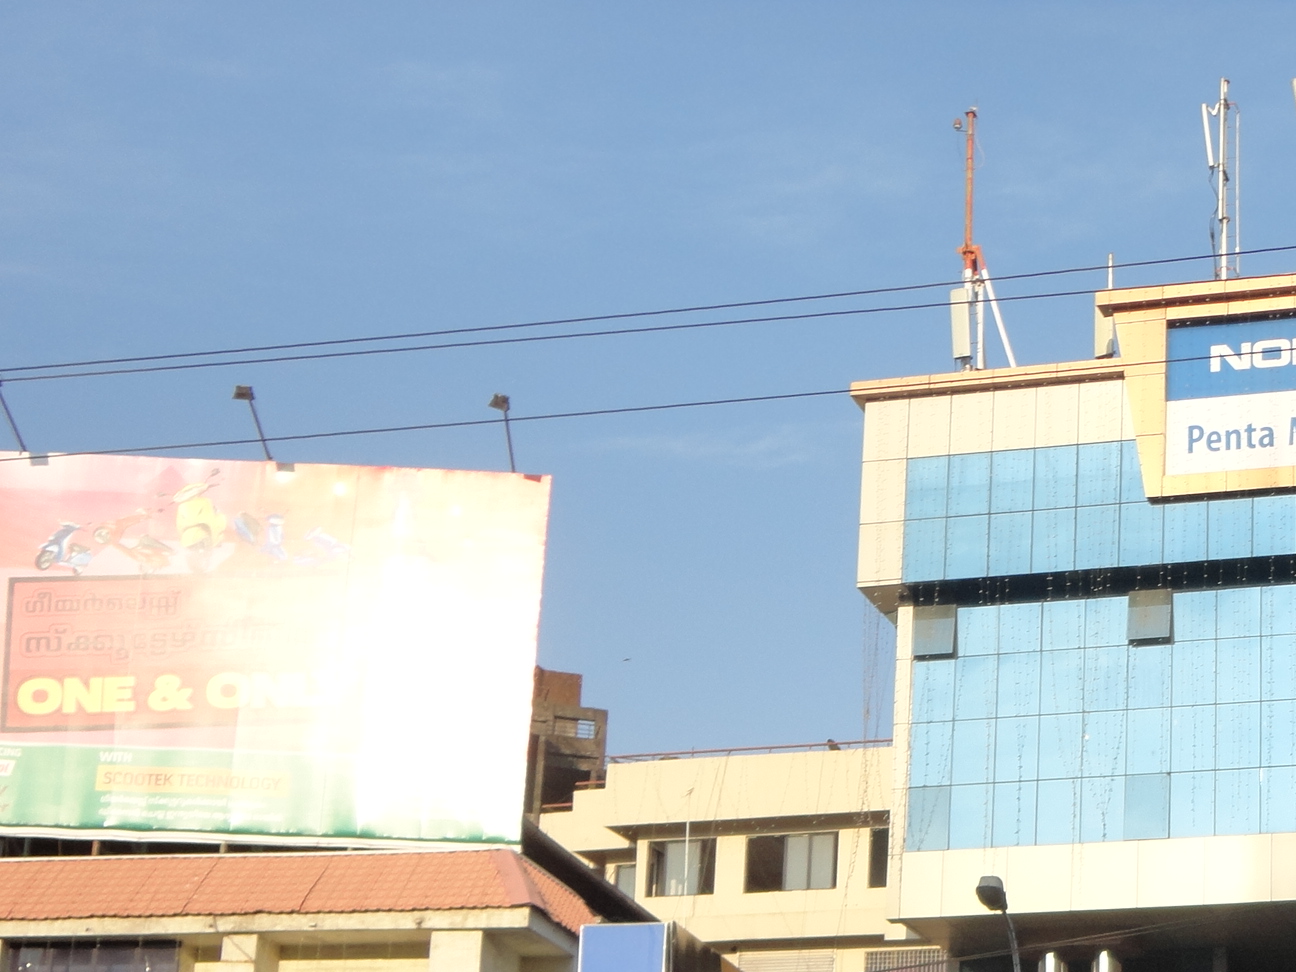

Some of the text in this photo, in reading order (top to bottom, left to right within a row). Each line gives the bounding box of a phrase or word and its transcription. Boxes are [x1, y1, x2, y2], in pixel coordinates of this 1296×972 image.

[1187, 422, 1275, 454] Penta
[17, 671, 357, 715] ONE & ONL
[100, 751, 132, 763] WITH
[103, 771, 281, 791] SCOOTEK TECHNOLOGY
